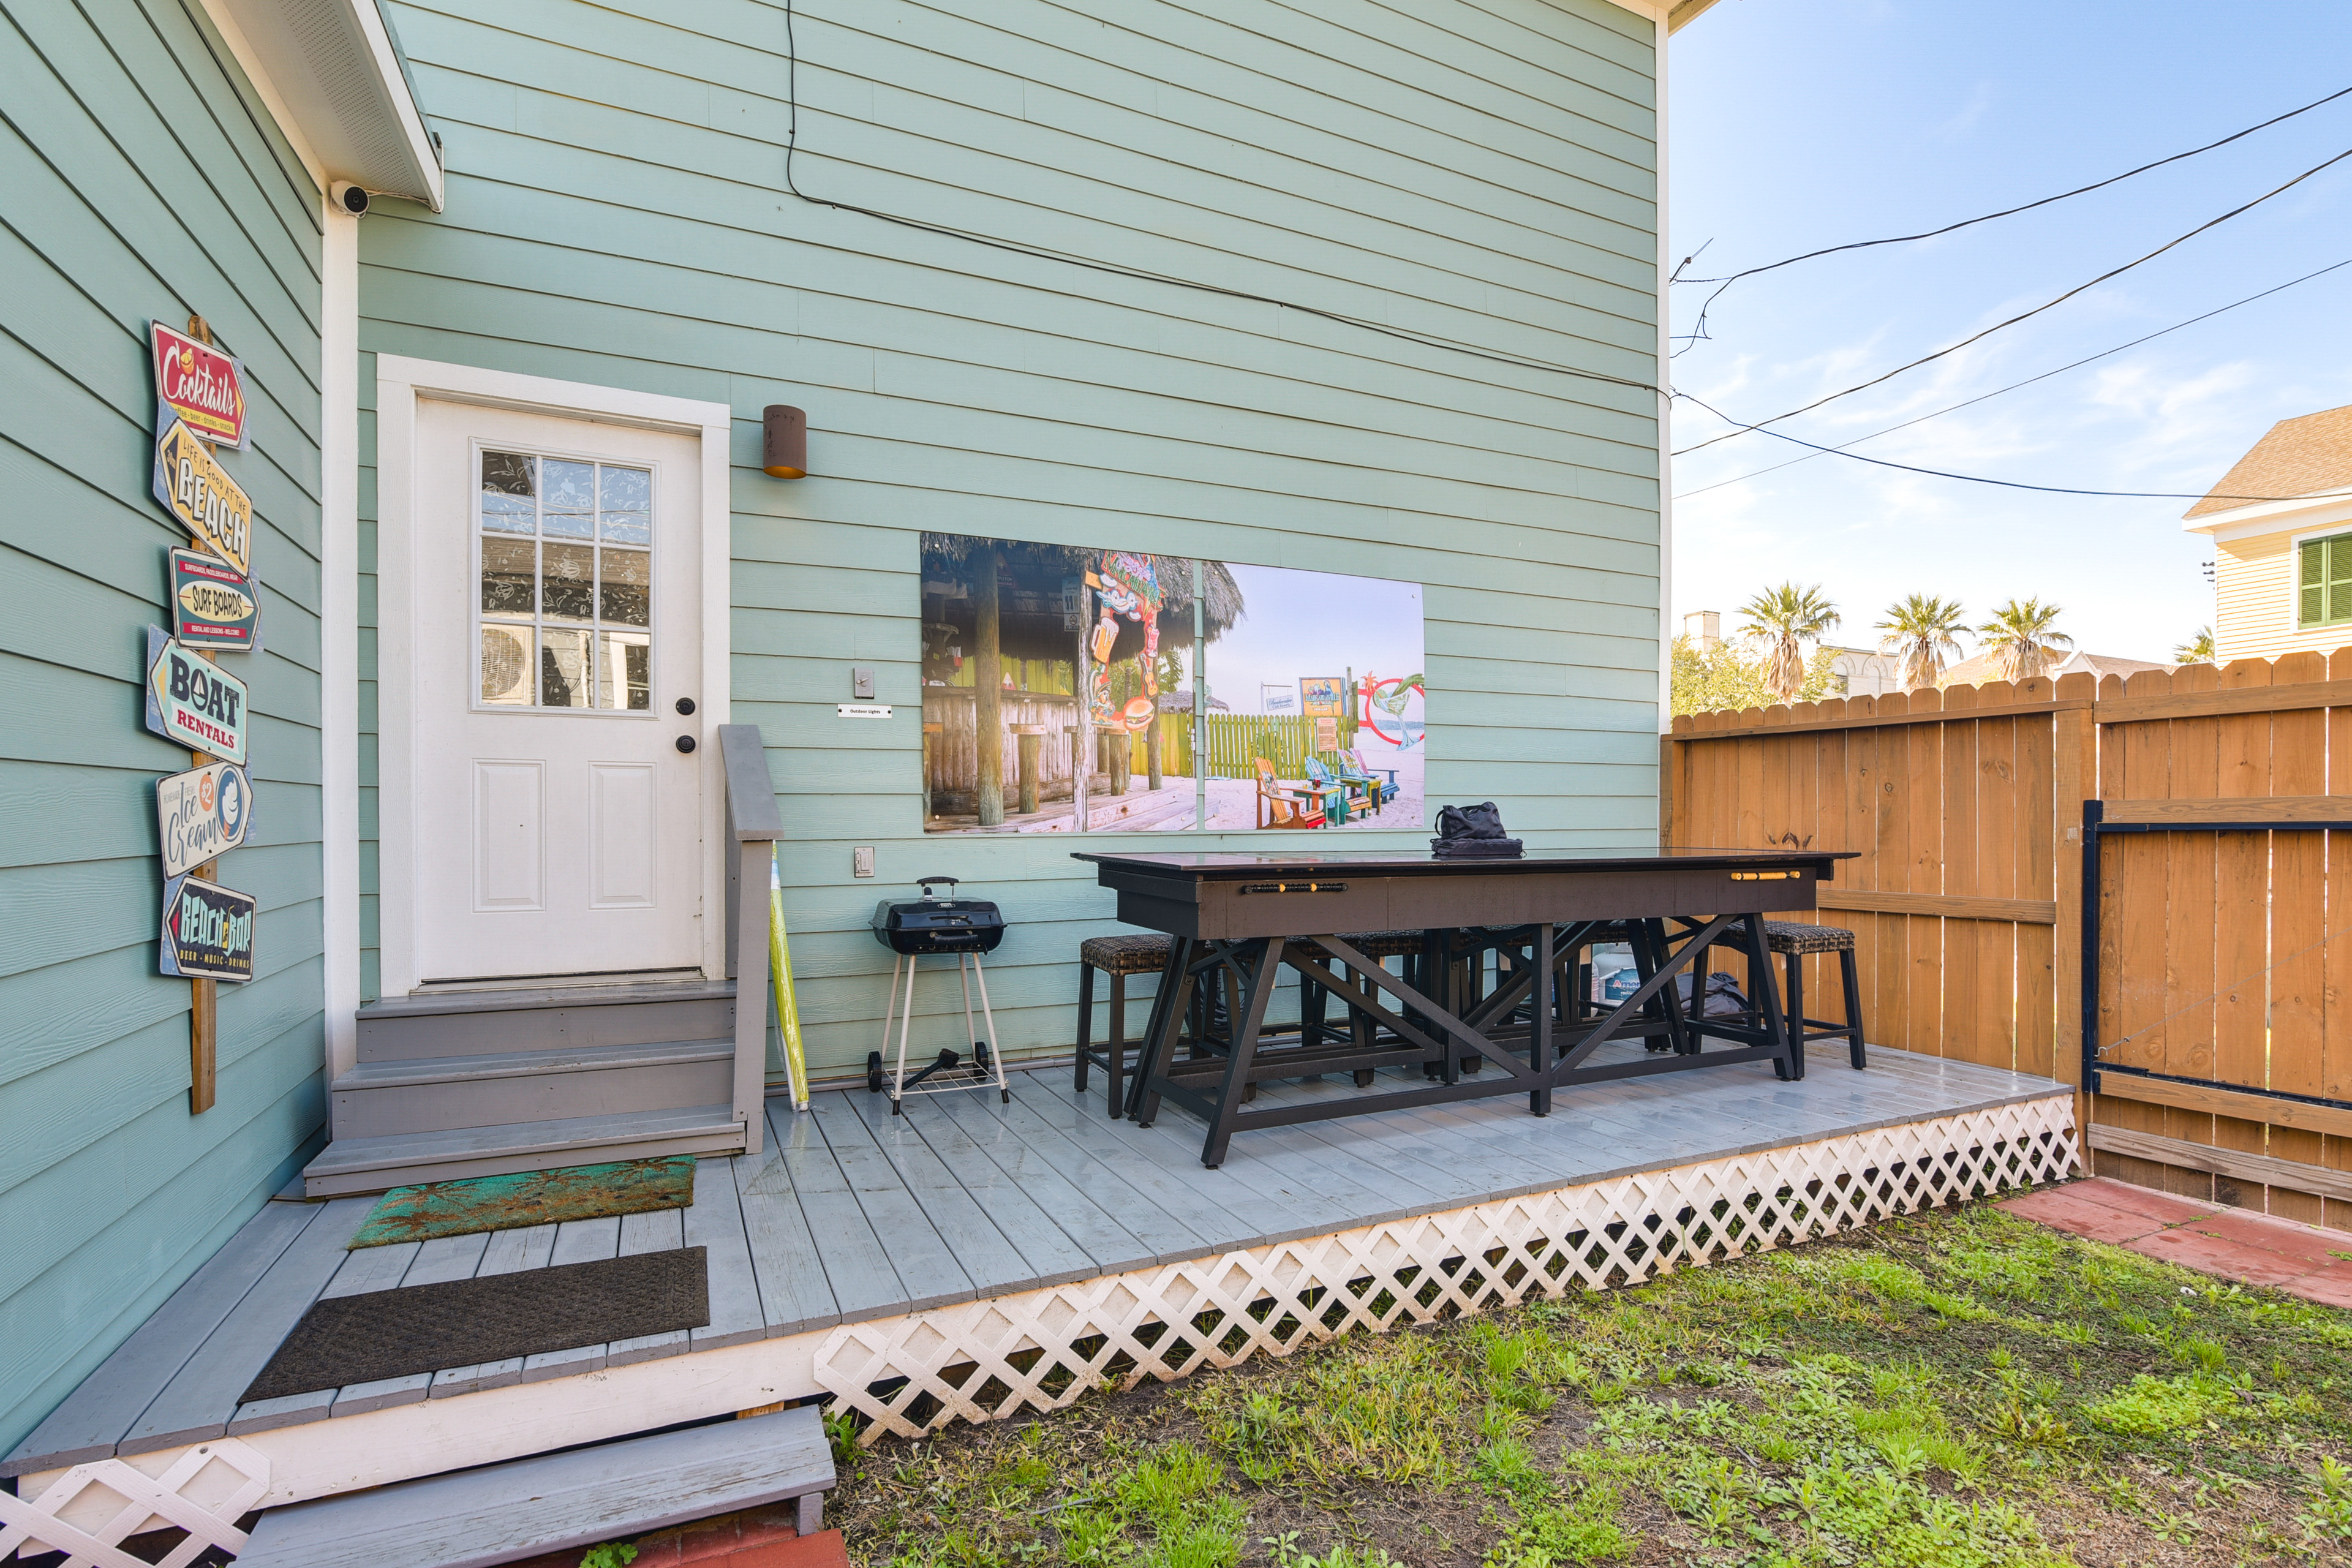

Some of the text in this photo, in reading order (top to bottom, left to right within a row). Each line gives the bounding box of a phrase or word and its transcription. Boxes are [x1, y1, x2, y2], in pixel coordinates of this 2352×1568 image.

[163, 341, 235, 417] Cocktails
[190, 411, 200, 422] beer
[204, 417, 217, 428] drinks
[219, 422, 233, 432] snacks
[183, 437, 246, 515] LIFE IS GOOD AT THE
[177, 457, 247, 567] BEACH
[192, 585, 243, 618] SURF BOARDS
[170, 652, 239, 728] BOAT
[177, 709, 235, 749] RENTALS
[180, 782, 198, 829] Ice
[201, 781, 213, 805] $2
[168, 816, 219, 867] Cream
[180, 891, 252, 957] BEACH BAR
[179, 949, 249, 968] BEER MUSIC DRINKS
